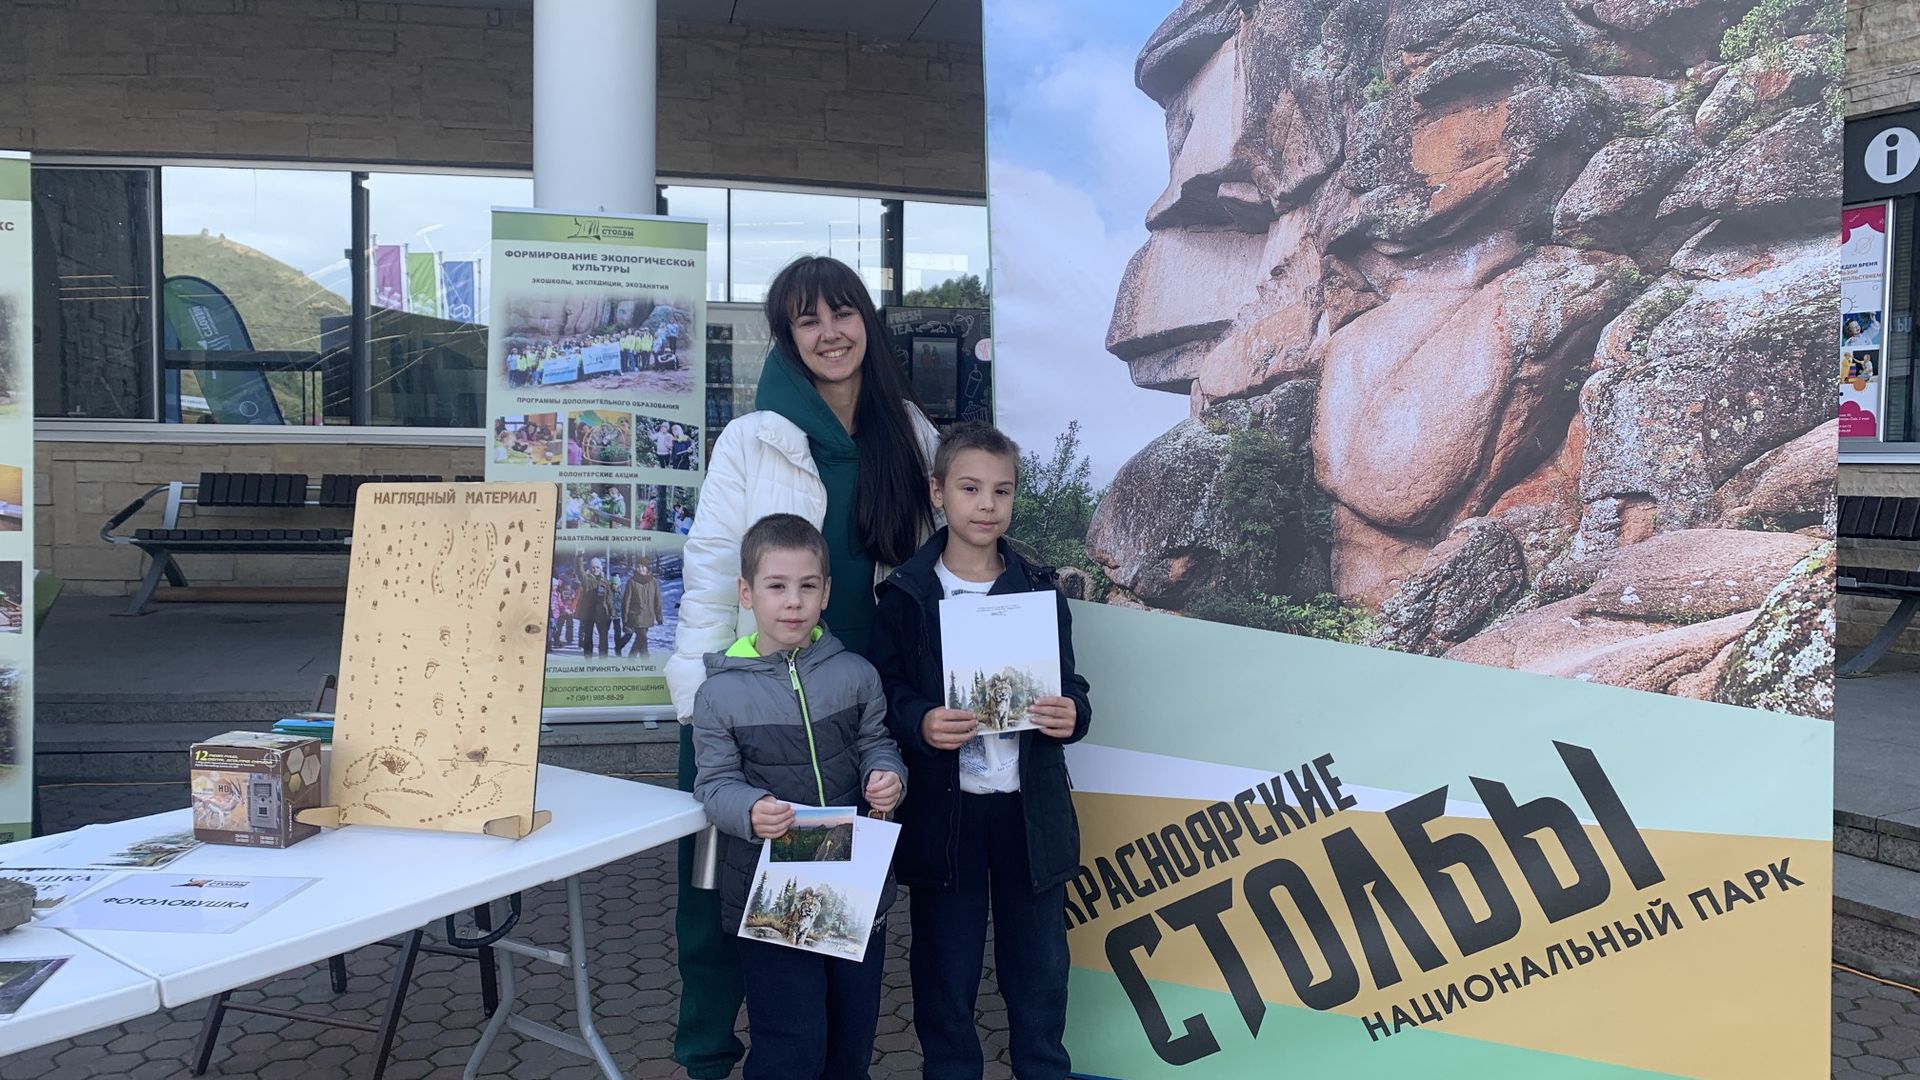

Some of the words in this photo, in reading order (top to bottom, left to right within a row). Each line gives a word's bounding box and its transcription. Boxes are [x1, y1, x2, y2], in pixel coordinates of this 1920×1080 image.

[602, 229, 634, 238] СТОЛБЫ
[504, 250, 598, 262] ФОРМИРОВАНИЕ
[601, 253, 695, 268] ЭКОЛОГИЧЕСКОЙ
[572, 263, 630, 274] КУЛЬТУРЫ
[532, 278, 574, 286] ЭКОШКОЛЫ,
[575, 279, 623, 288] ЭКСПЕДИЦИИ,
[625, 281, 669, 291] ЭКОЗАНЯТИЯ
[888, 310, 922, 325] FRESH
[890, 324, 914, 336] TEA
[517, 397, 561, 405] ПРОГРАММЫ
[562, 398, 631, 407] ДОПОЛНИТЕЛЬНОГО
[632, 401, 680, 410] ОБРАЗОВАНИЯ
[374, 489, 456, 506] НАГЛЯДНЫЙ
[465, 491, 537, 505] МАТЕРИАЛ
[586, 665, 620, 673] ПРИНЯТЬ
[549, 685, 611, 693] ЭКОЛОГИЧЕСКОГО
[612, 684, 665, 692] ПРОСВЕЩЕНИЯ
[195, 750, 209, 761] 12
[218, 784, 230, 793] HD
[1064, 752, 1358, 930] КРАСНОЯРСКИЕ
[103, 897, 250, 909] ФОТОЛОВУШКА
[1105, 740, 1665, 1066] СТОЛБЫ
[1362, 897, 1684, 1043] НАЦИОНАЛЬНЫЙ
[1688, 857, 1805, 921] ПАРК
